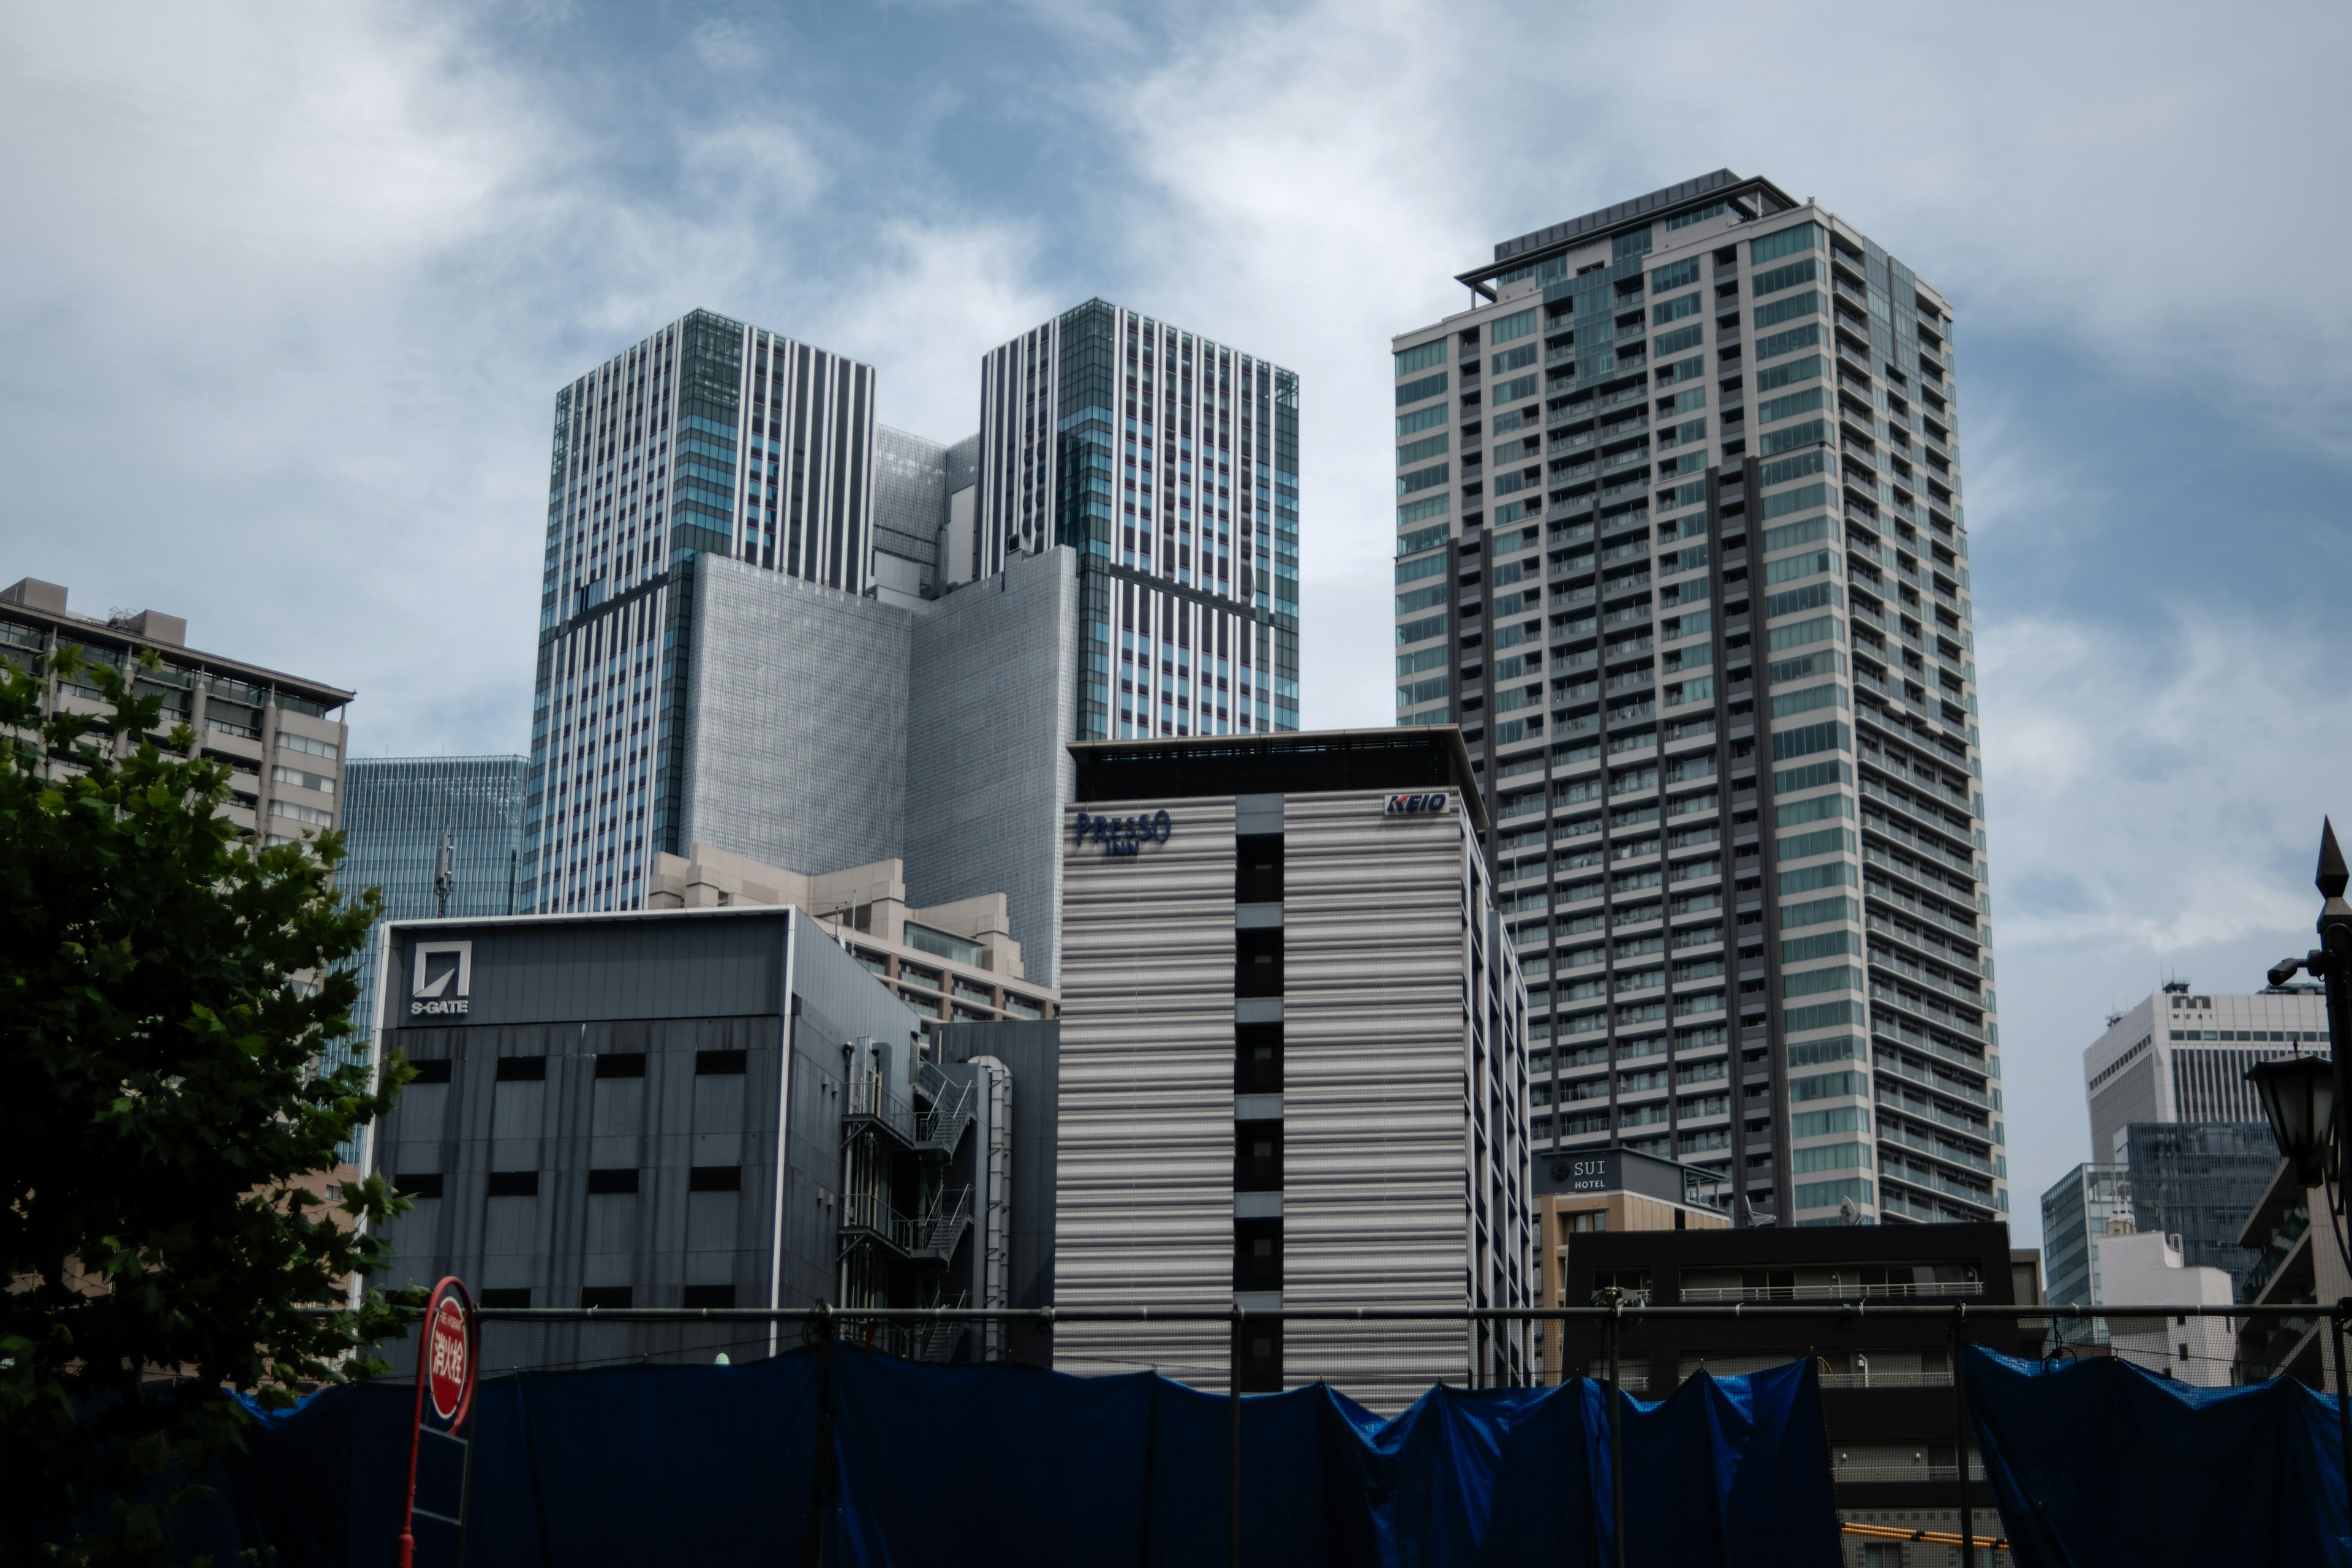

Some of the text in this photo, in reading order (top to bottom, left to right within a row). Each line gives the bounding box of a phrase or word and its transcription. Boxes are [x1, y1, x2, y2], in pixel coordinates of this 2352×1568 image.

[1387, 793, 1446, 812] KEIO
[1076, 809, 1171, 846] PRESSO
[1106, 840, 1139, 856] INN
[411, 999, 469, 1015] S-GATE
[1574, 1160, 1606, 1176] SUI
[1575, 1180, 1606, 1189] HOTEL
[432, 1330, 464, 1385] 消火栓
